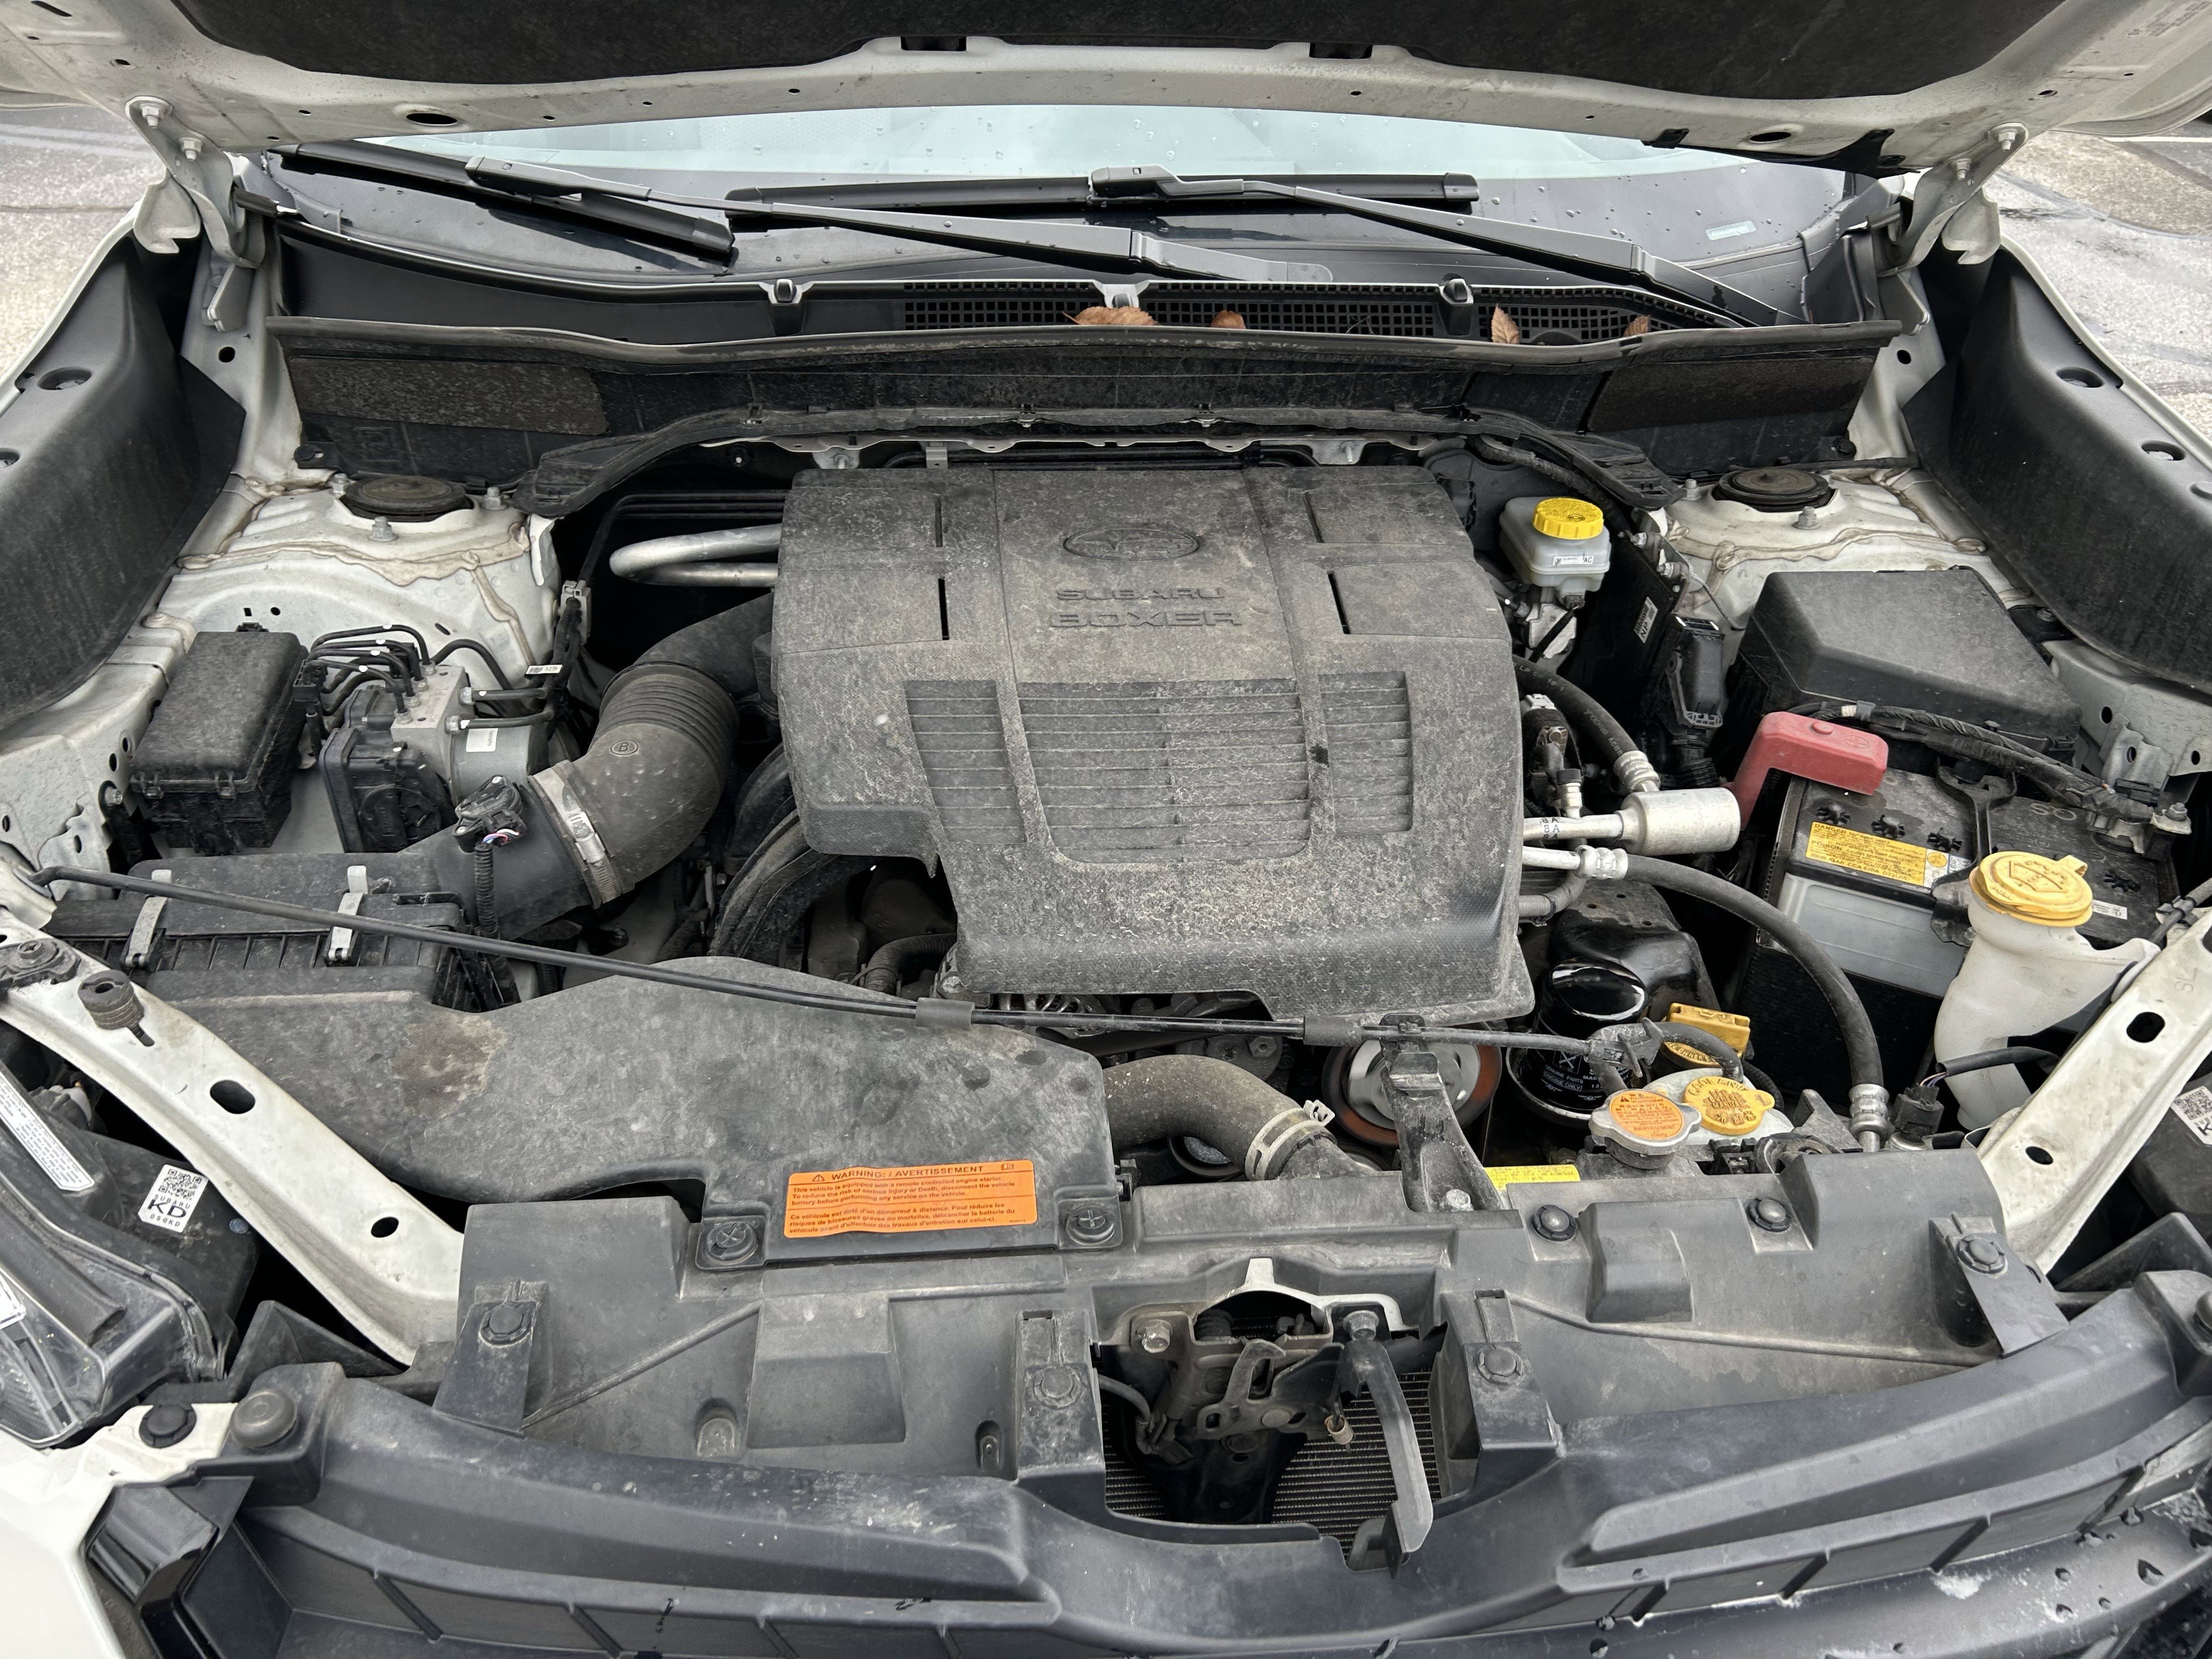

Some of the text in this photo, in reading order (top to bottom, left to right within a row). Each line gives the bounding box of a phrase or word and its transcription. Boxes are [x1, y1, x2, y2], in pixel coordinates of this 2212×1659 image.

[1056, 587, 1226, 600] SUBARU
[1049, 611, 1243, 628] BOXER
[618, 742, 629, 752] B
[1544, 824, 1560, 833] 8 A
[1814, 823, 1846, 834] DANGER
[1811, 839, 1842, 851] POISON
[1565, 1082, 1581, 1090] ONLY
[832, 1170, 885, 1180] WARNING:
[895, 1166, 984, 1177] AVERTISSEMENT
[154, 1194, 190, 1209] SUBARU
[147, 1198, 187, 1218] KD
[828, 1216, 861, 1224] blessures
